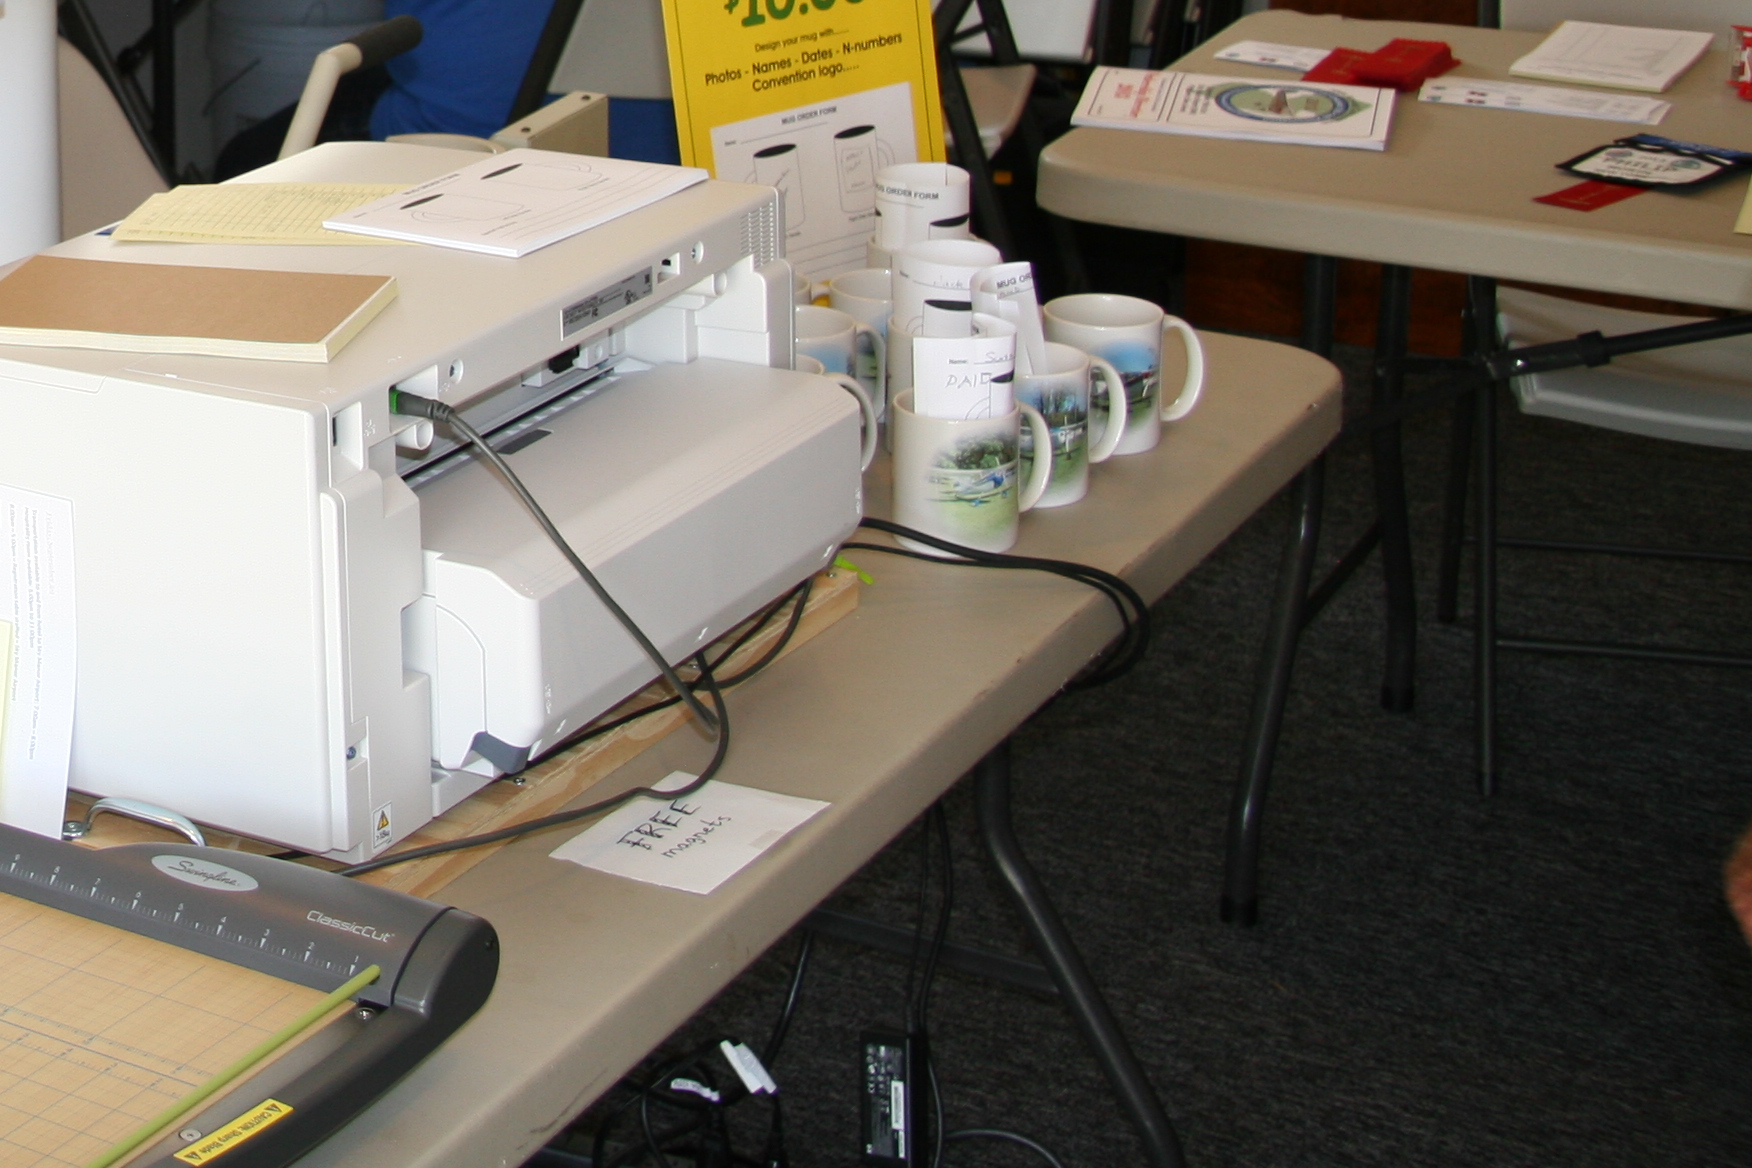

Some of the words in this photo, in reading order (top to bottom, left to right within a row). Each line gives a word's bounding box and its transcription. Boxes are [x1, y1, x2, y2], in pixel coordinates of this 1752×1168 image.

[755, 38, 781, 53] Design
[781, 36, 798, 49] your
[799, 32, 818, 44] mug
[705, 67, 742, 86] Photos
[752, 57, 792, 76] Names
[801, 47, 833, 65] Dates
[842, 33, 902, 55] N-numbers
[752, 70, 816, 92] Convention
[781, 116, 796, 125] MUG
[797, 110, 818, 122] ORDER
[819, 106, 837, 117] FORM
[886, 187, 912, 197] ORDER
[914, 190, 939, 200] FORM
[997, 278, 1017, 288] MUG
[616, 799, 702, 851] FREE
[661, 815, 732, 858] magnets
[167, 860, 238, 887] Swingline
[15, 853, 21, 861] 9
[95, 878, 101, 886] 7
[177, 903, 184, 911] 5
[264, 928, 270, 936] 3
[308, 941, 315, 950] 2
[354, 955, 359, 963] 1
[306, 910, 389, 943] ClassicCut
[199, 1140, 224, 1154] Blade
[217, 1129, 243, 1143] Sharp
